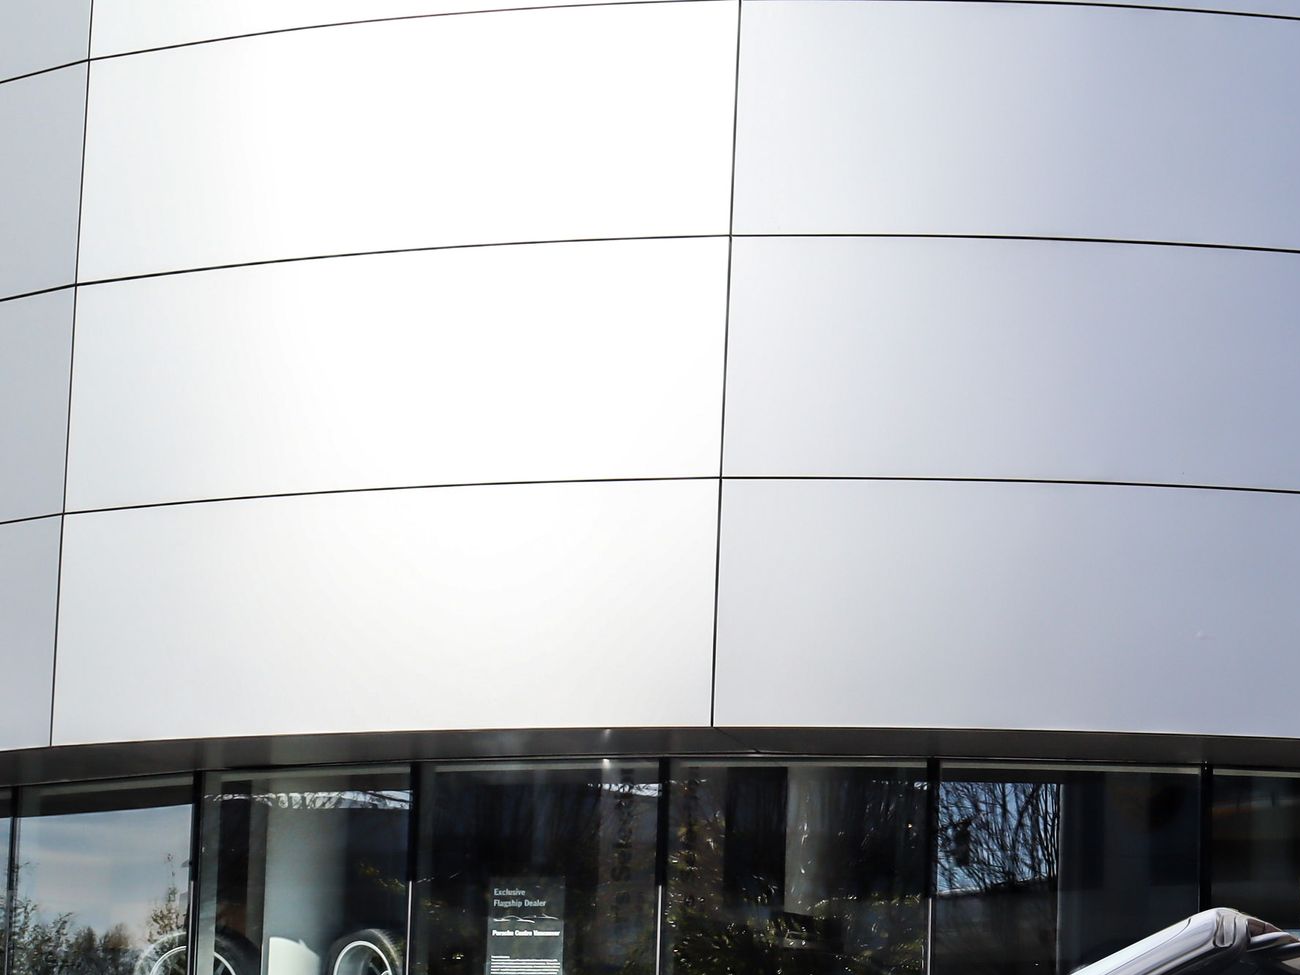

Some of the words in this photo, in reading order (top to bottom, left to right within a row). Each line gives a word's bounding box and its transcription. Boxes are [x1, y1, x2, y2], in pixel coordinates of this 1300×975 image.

[493, 888, 525, 896] Exclusive
[493, 899, 522, 908] Flagship
[524, 899, 547, 907] Dealer
